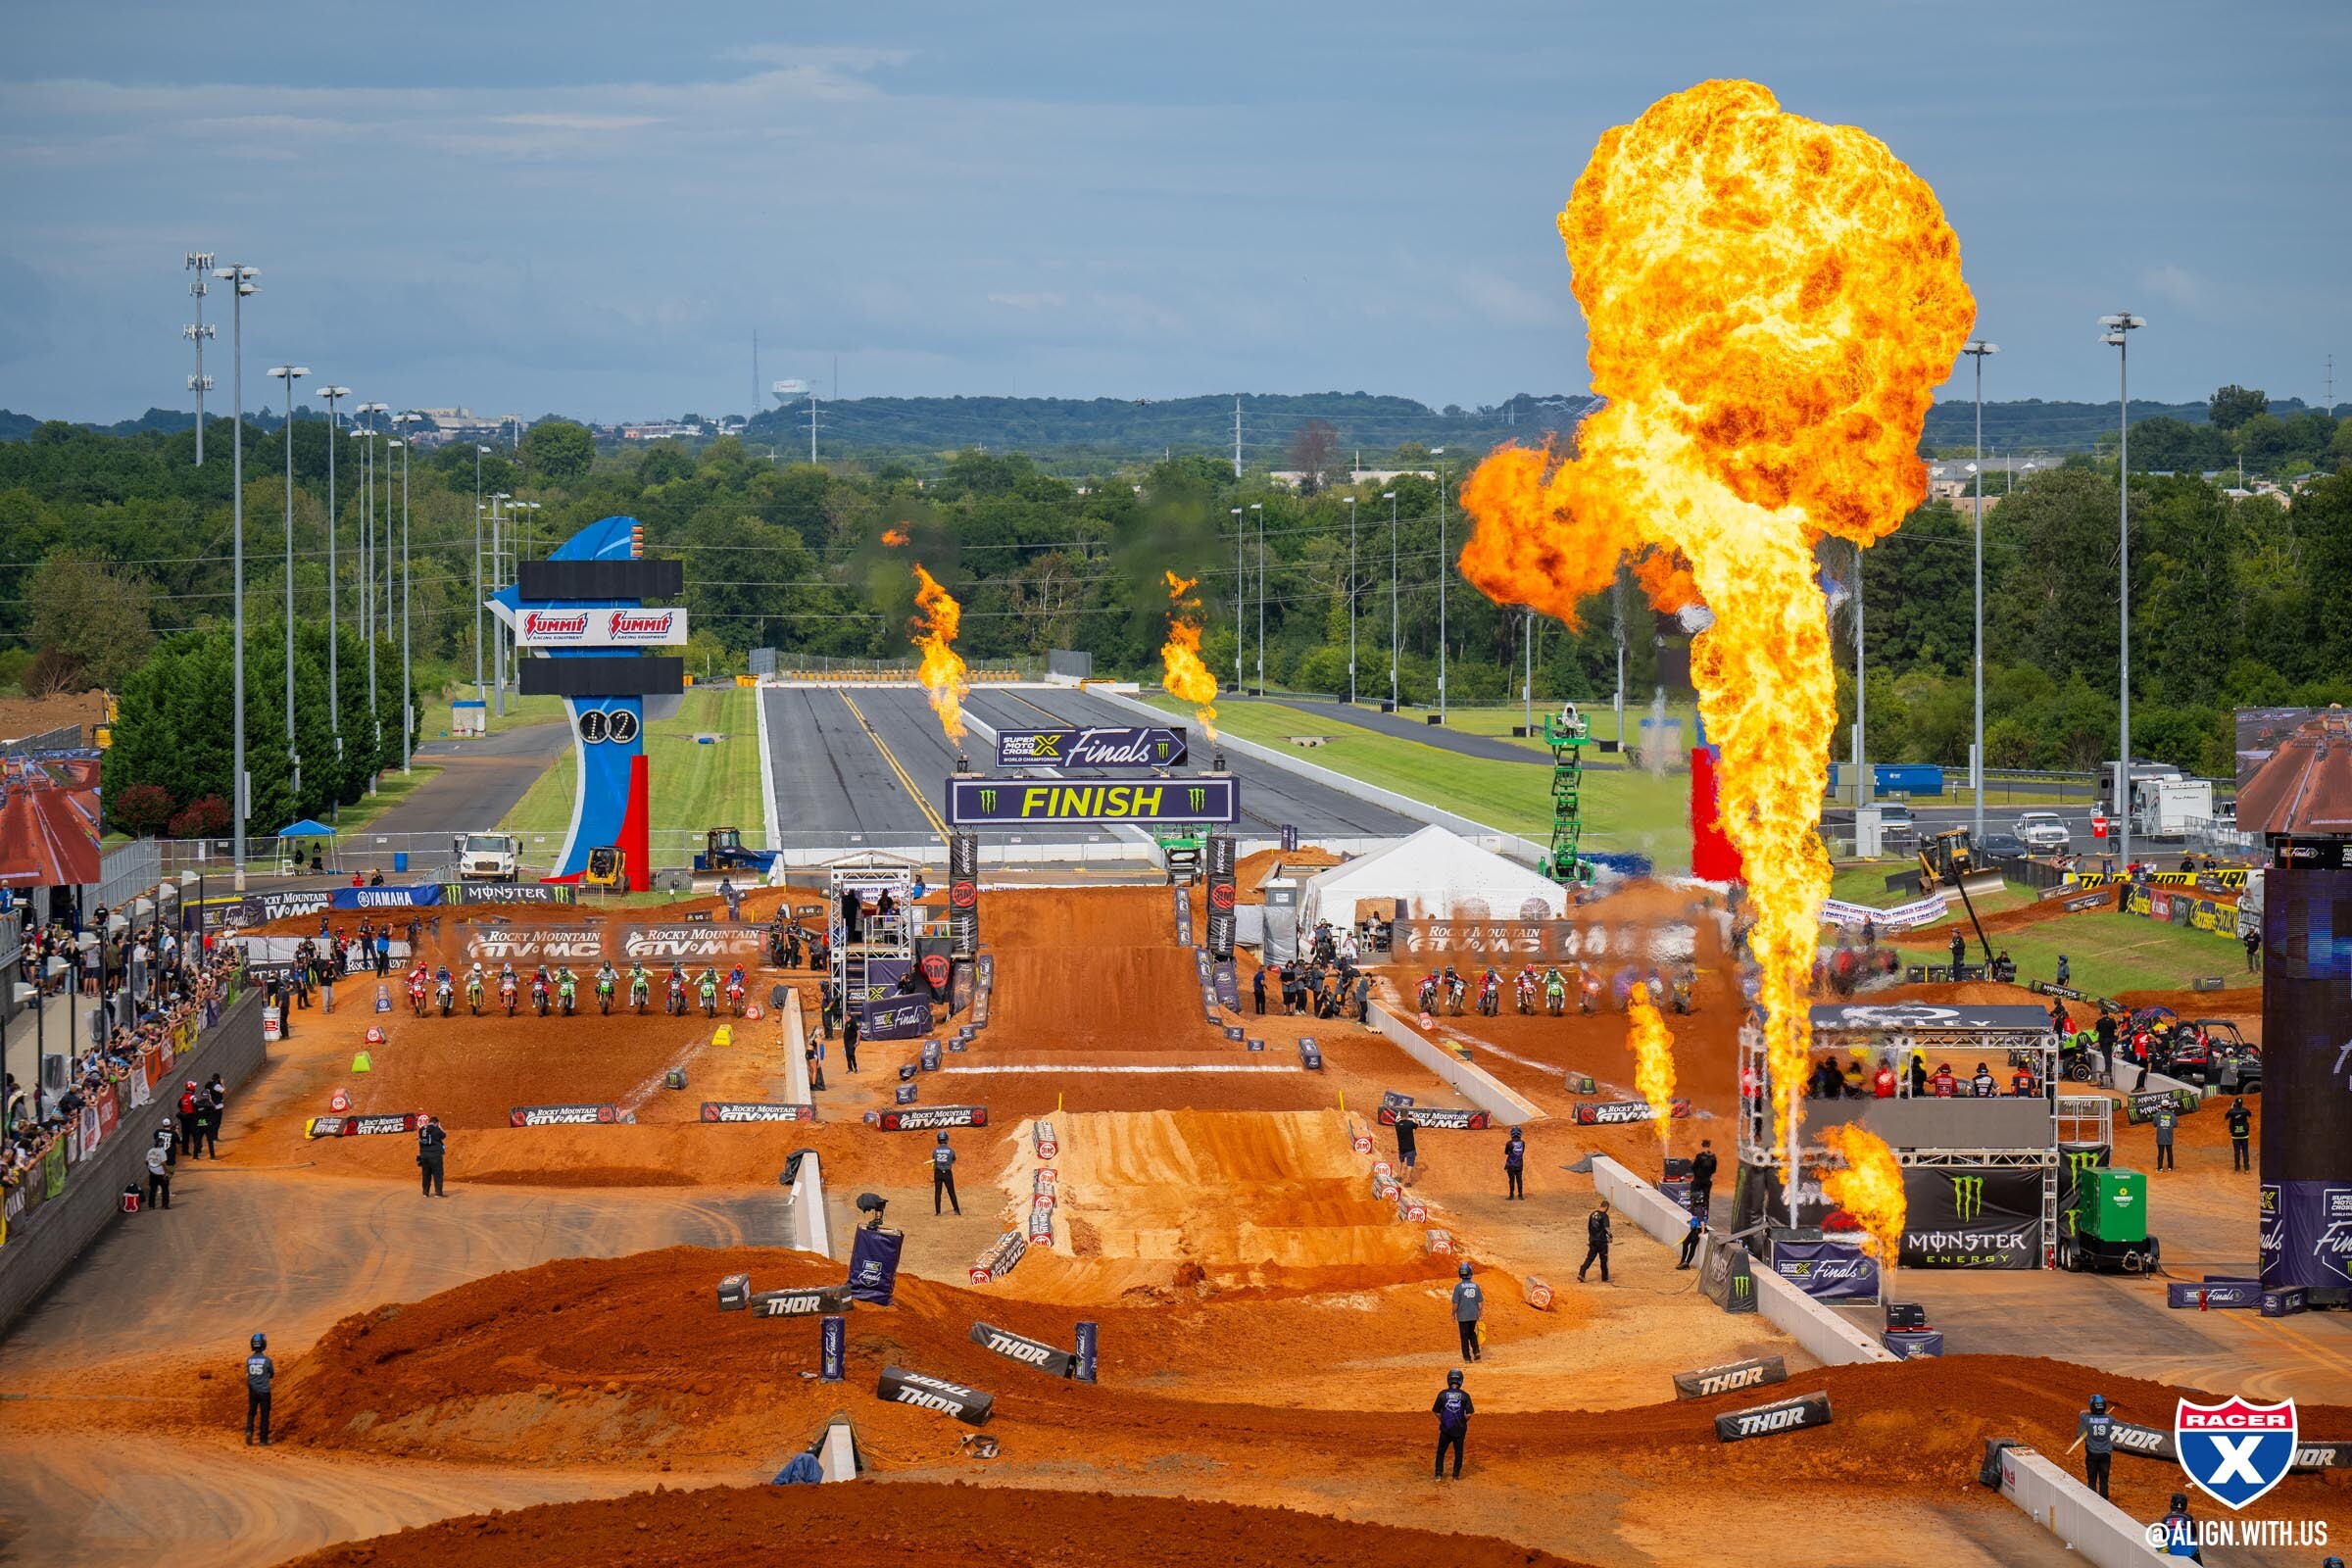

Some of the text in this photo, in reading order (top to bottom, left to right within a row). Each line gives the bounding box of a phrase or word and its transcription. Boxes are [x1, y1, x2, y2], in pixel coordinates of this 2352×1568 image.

[1065, 728, 1151, 766] Finals
[1021, 787, 1163, 817] FINISH
[283, 893, 327, 903] MOUNTAIN
[368, 892, 413, 906] YAMAHA
[468, 885, 547, 900] MONSTER
[489, 931, 600, 941] ROCKY MOUNTAIN
[647, 929, 760, 940] ROCKY MOUNTAIN
[347, 959, 374, 971] ROCY
[2043, 984, 2078, 999] MONSTER
[2137, 1093, 2171, 1103] MONSTER
[1432, 1111, 1469, 1120] MOUNTAIN
[937, 1153, 948, 1162] 22
[1908, 1231, 2027, 1252] MONSTER
[2313, 1219, 2352, 1255] Fin
[1813, 1259, 1858, 1280] Finals
[2206, 1289, 2234, 1301] Finals
[767, 1296, 820, 1315] THOR
[986, 1333, 1050, 1366] THOR
[1698, 1366, 1763, 1396] THOR
[897, 1385, 963, 1418] THOR
[1738, 1406, 1805, 1436] THOR
